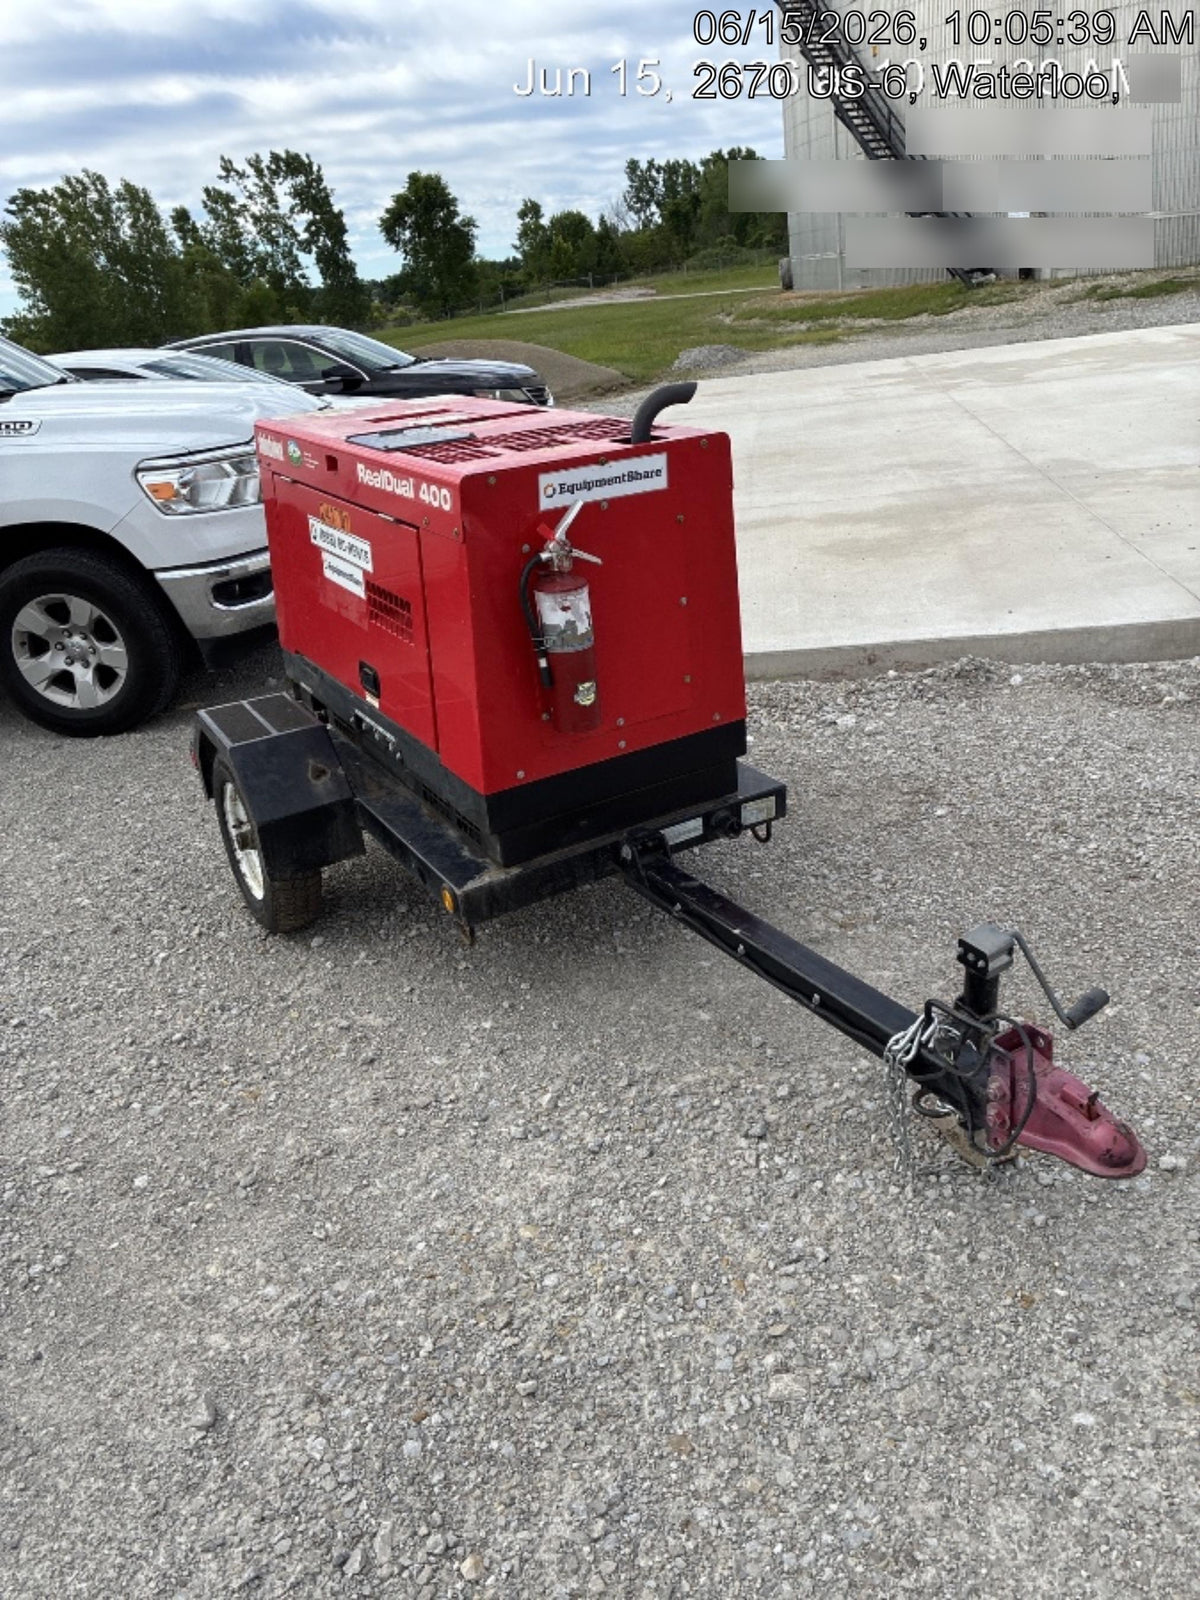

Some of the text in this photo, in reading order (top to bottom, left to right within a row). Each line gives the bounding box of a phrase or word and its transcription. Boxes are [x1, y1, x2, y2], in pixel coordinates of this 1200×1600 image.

[357, 463, 451, 511] RealDual 400
[558, 469, 662, 494] EquipmentShare
